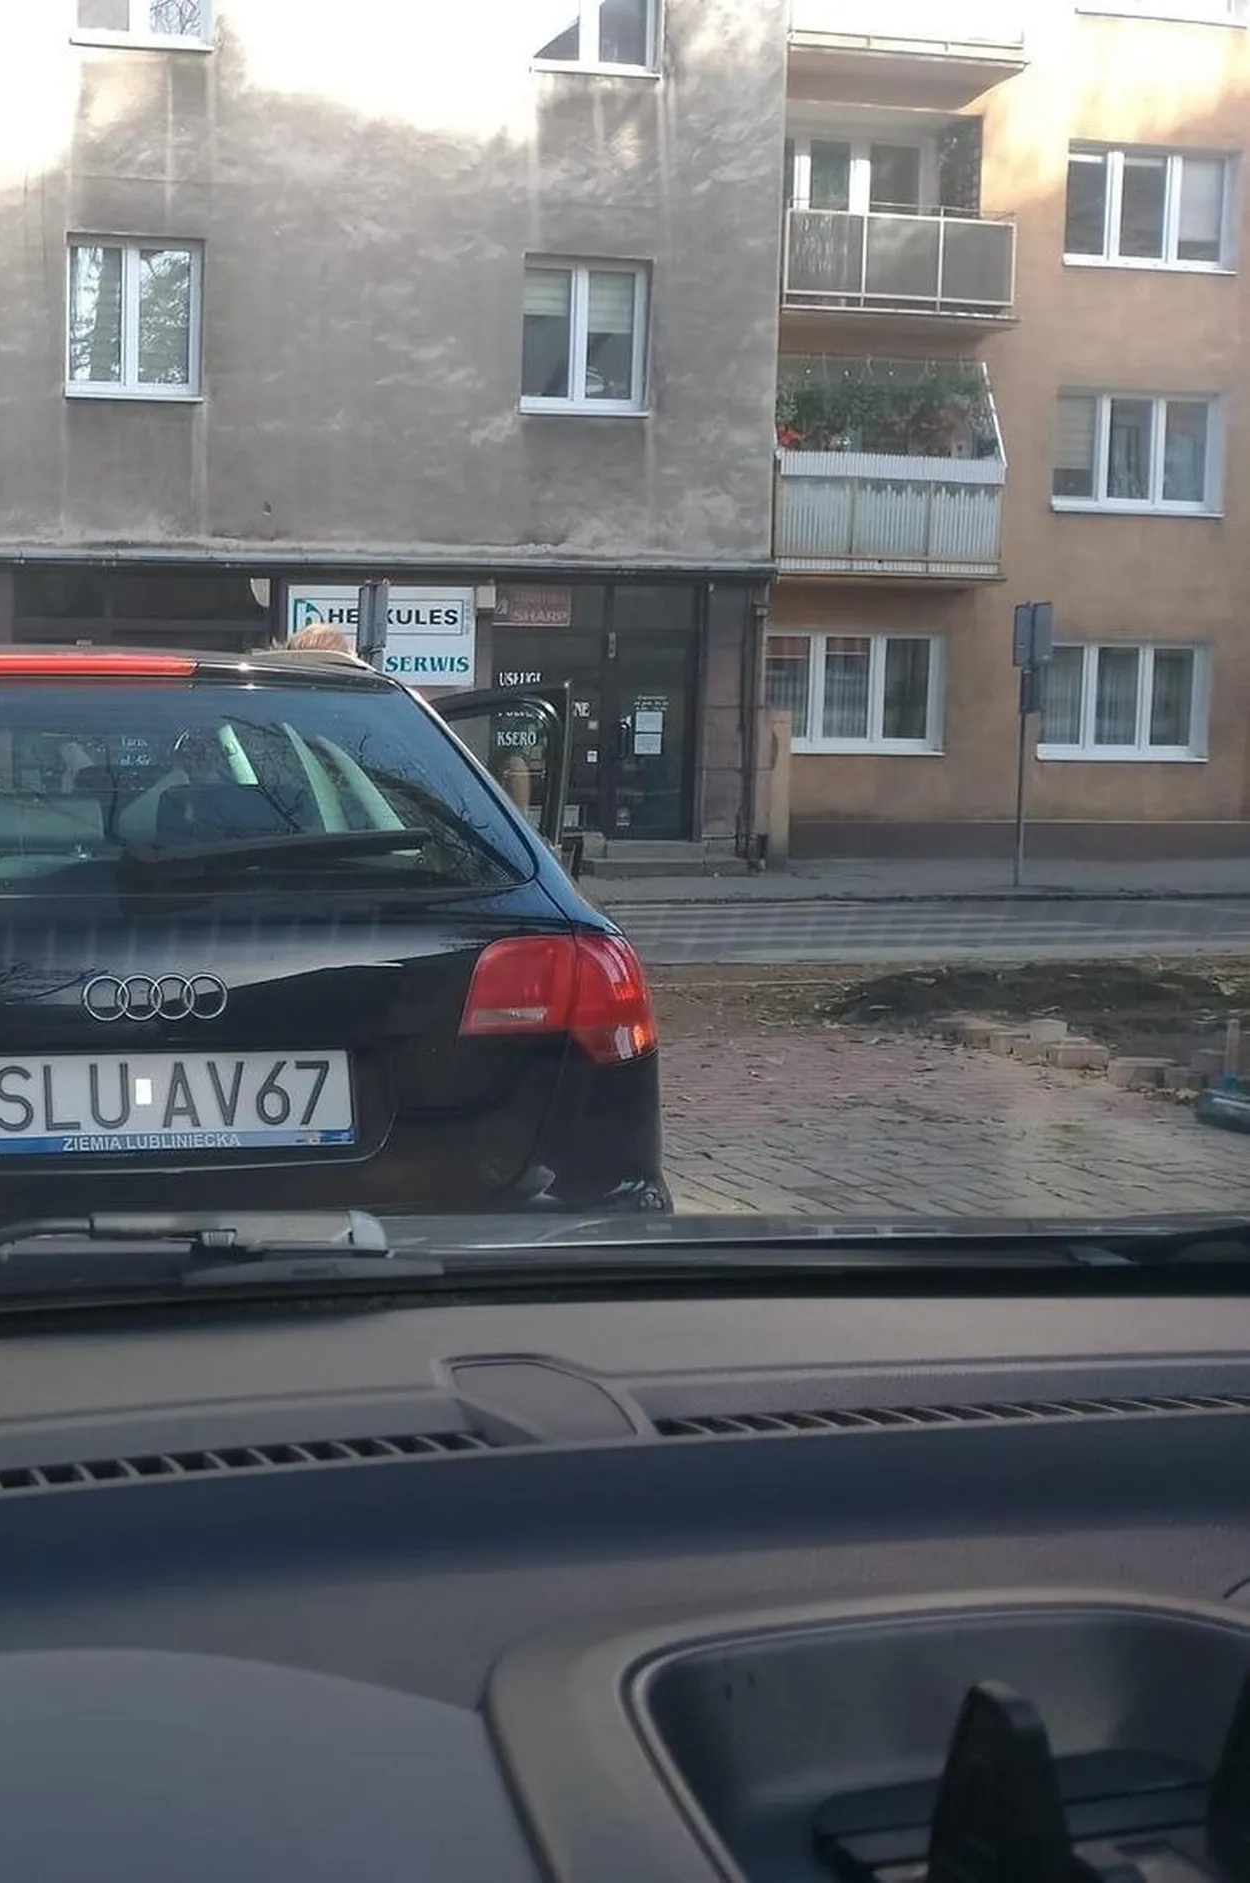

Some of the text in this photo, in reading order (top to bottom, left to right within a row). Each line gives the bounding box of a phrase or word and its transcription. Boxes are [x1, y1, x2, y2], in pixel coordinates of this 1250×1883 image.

[328, 608, 459, 626] HEKULES
[384, 656, 470, 673] SERWIS
[496, 731, 537, 747] KSERO
[162, 1060, 330, 1128] AV67
[62, 1133, 242, 1152] ZIEMIA LUBLINIECKA
